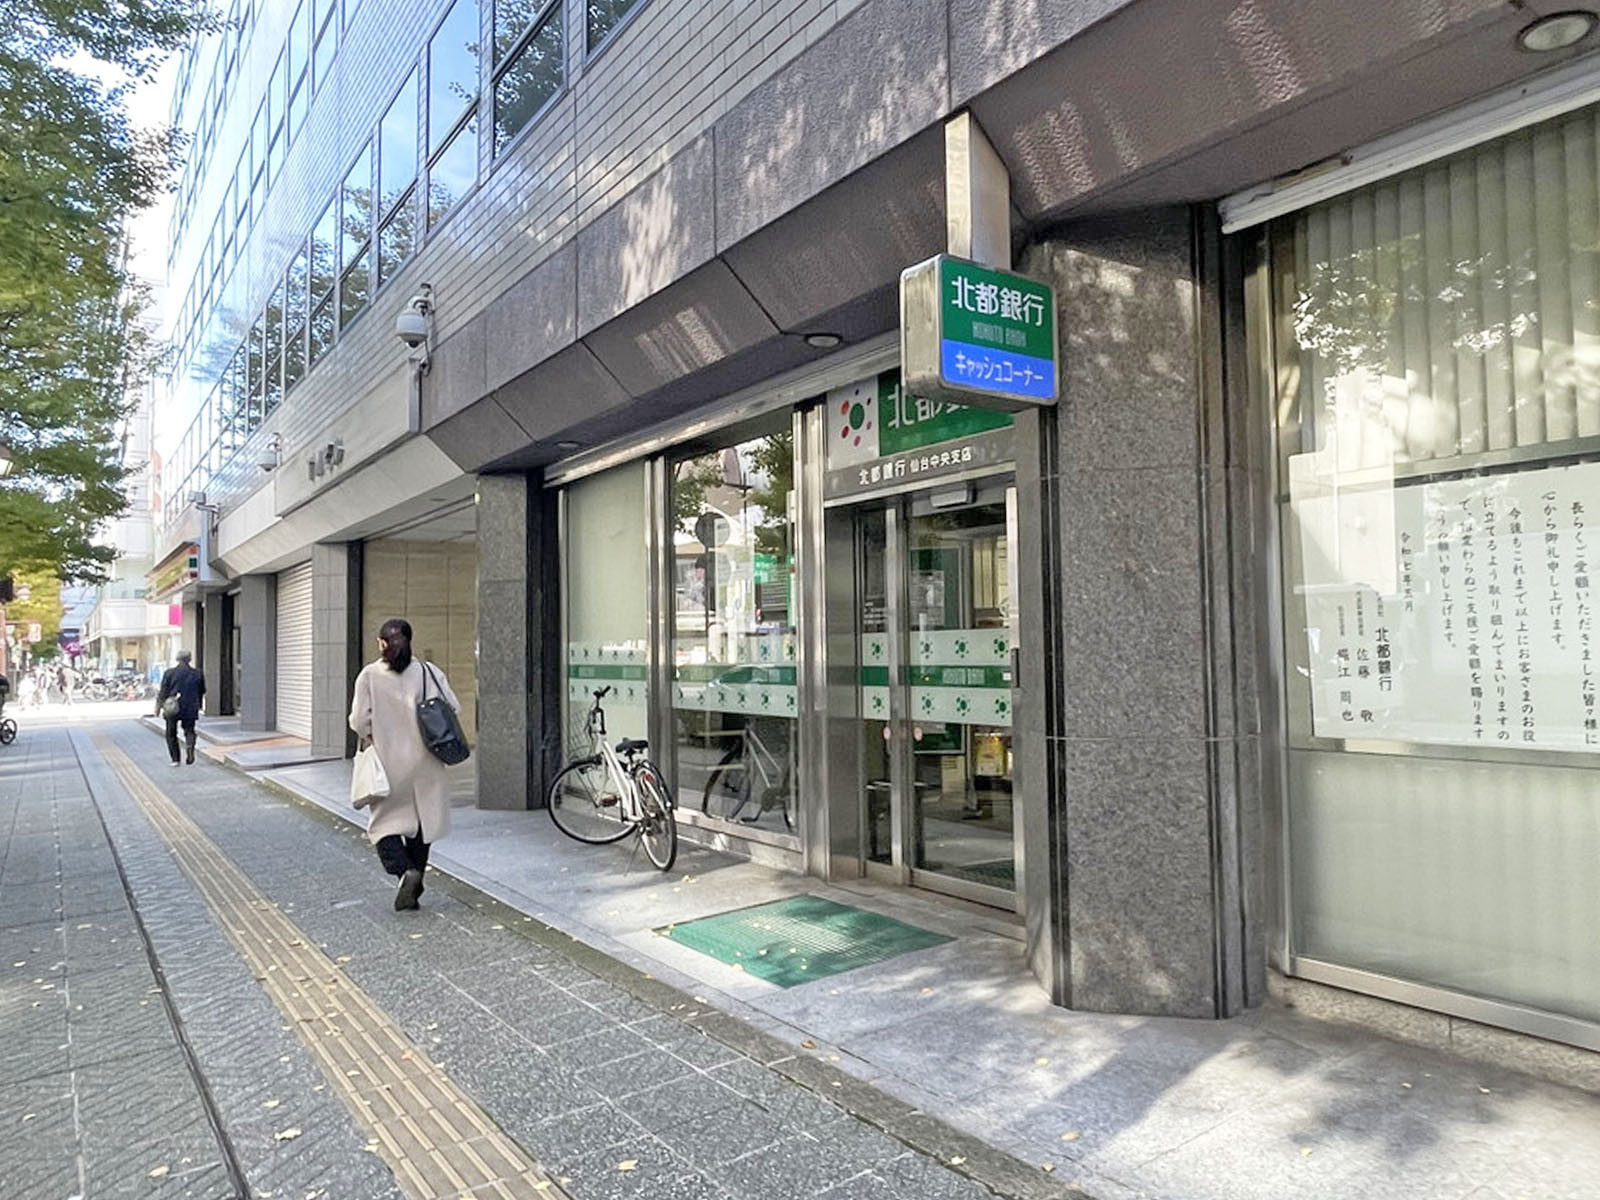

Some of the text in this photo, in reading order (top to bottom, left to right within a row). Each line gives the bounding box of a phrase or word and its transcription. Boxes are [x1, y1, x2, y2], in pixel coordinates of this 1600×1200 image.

[951, 275, 1045, 327] 北都銀行
[955, 350, 1044, 387] キャッシュコーナー
[858, 446, 972, 485] 北都銀行 仙台中央支店
[1375, 626, 1392, 691] 北都銀行
